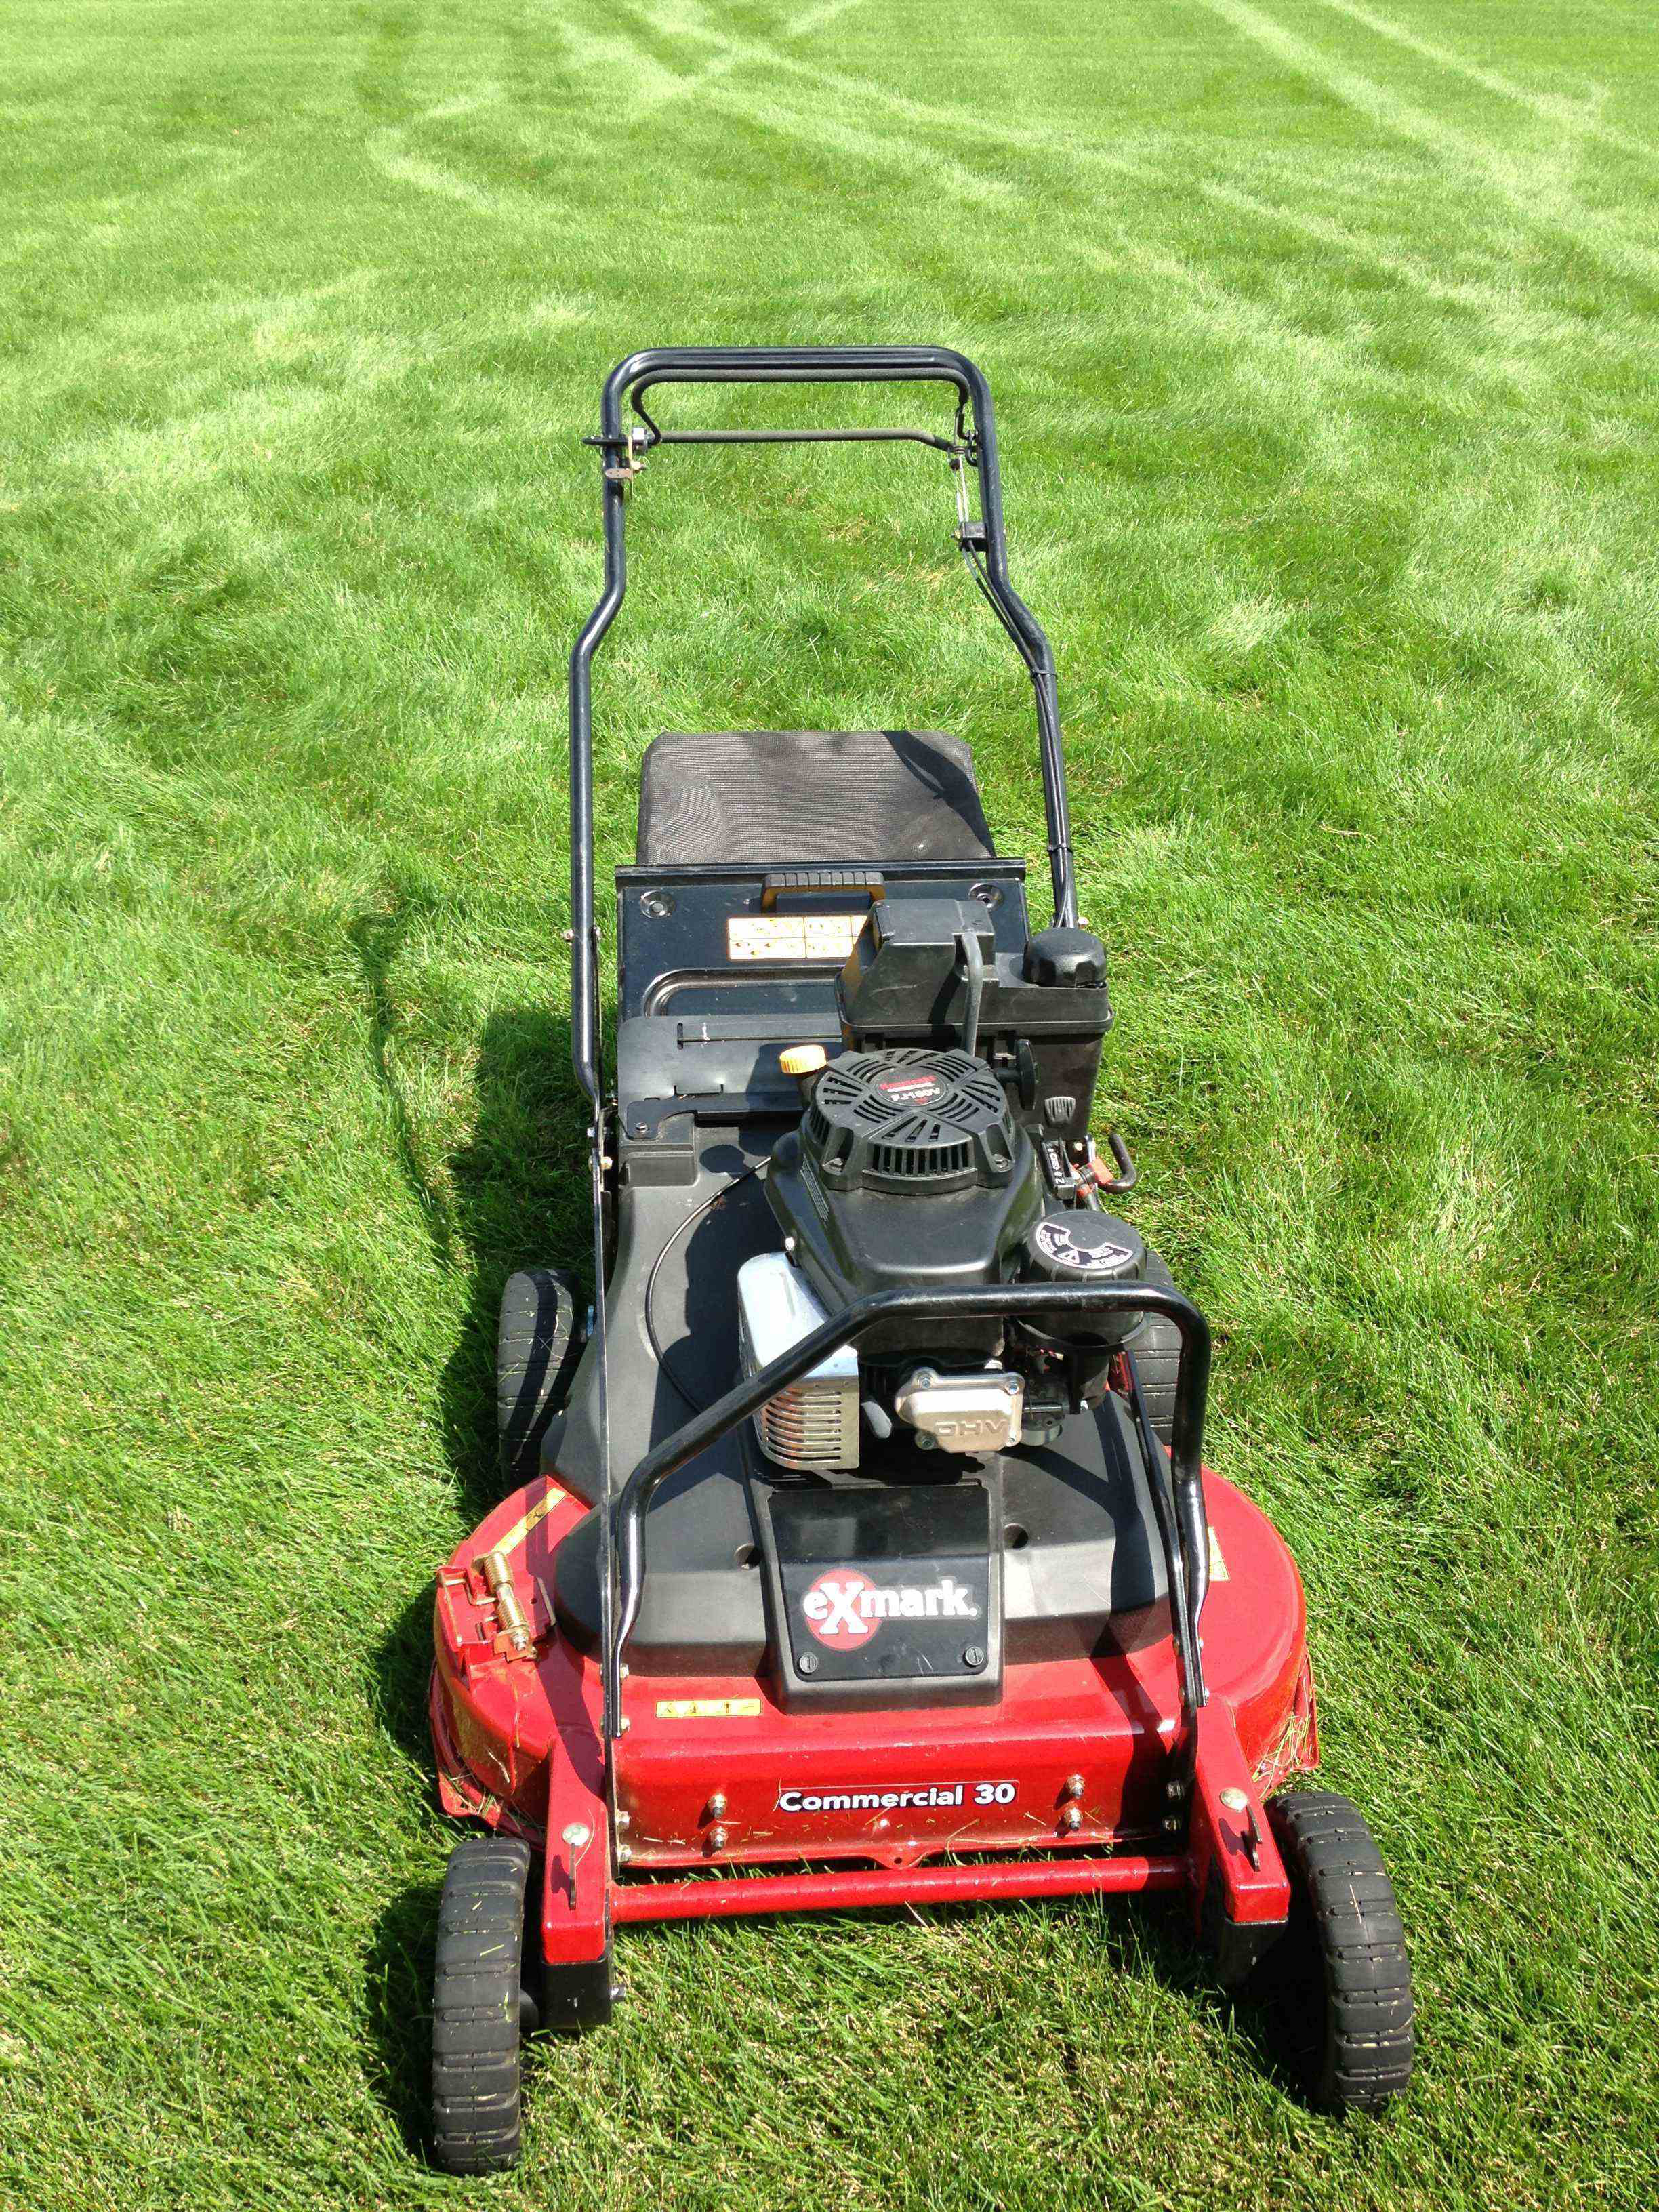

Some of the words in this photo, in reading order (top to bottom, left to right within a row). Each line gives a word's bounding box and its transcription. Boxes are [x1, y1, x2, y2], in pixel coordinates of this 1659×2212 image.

[935, 1420, 1008, 1437] OHV
[779, 1784, 964, 1811] Commercial
[974, 1782, 1015, 1805] 30
